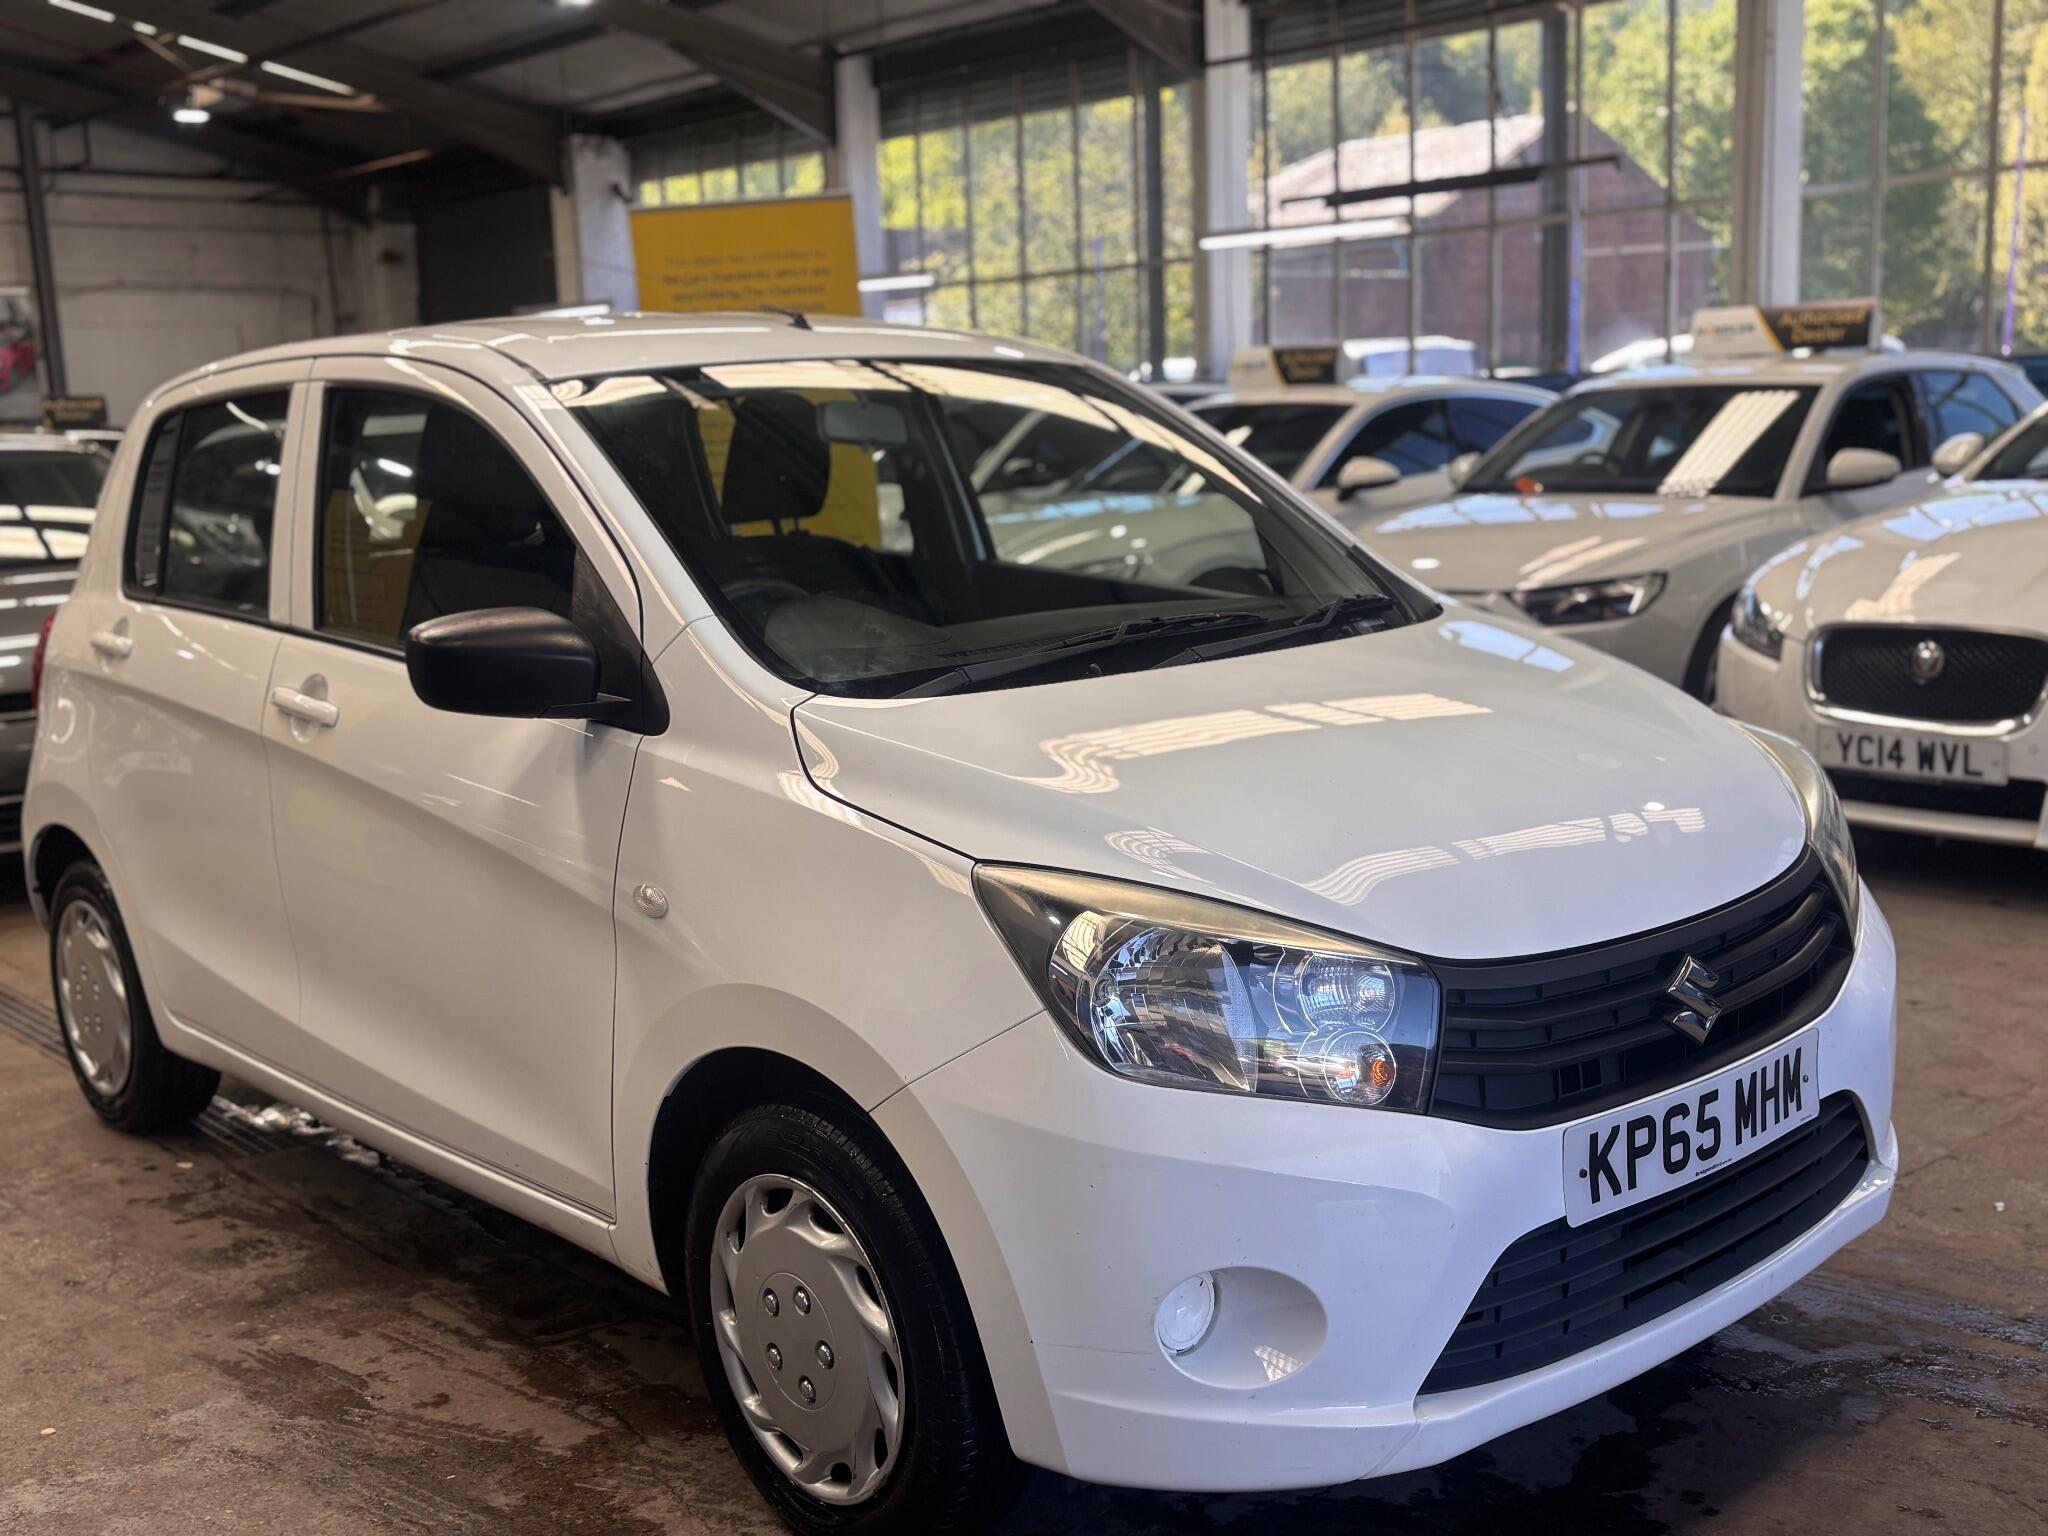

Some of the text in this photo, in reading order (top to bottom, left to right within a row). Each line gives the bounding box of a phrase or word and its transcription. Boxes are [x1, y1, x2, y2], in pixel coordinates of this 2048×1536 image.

[1779, 307, 1868, 327] Authorised
[1790, 326, 1848, 344] Dealer
[1838, 732, 1983, 777] YC14 WVL
[1588, 1046, 1802, 1205] KP65 MHM
